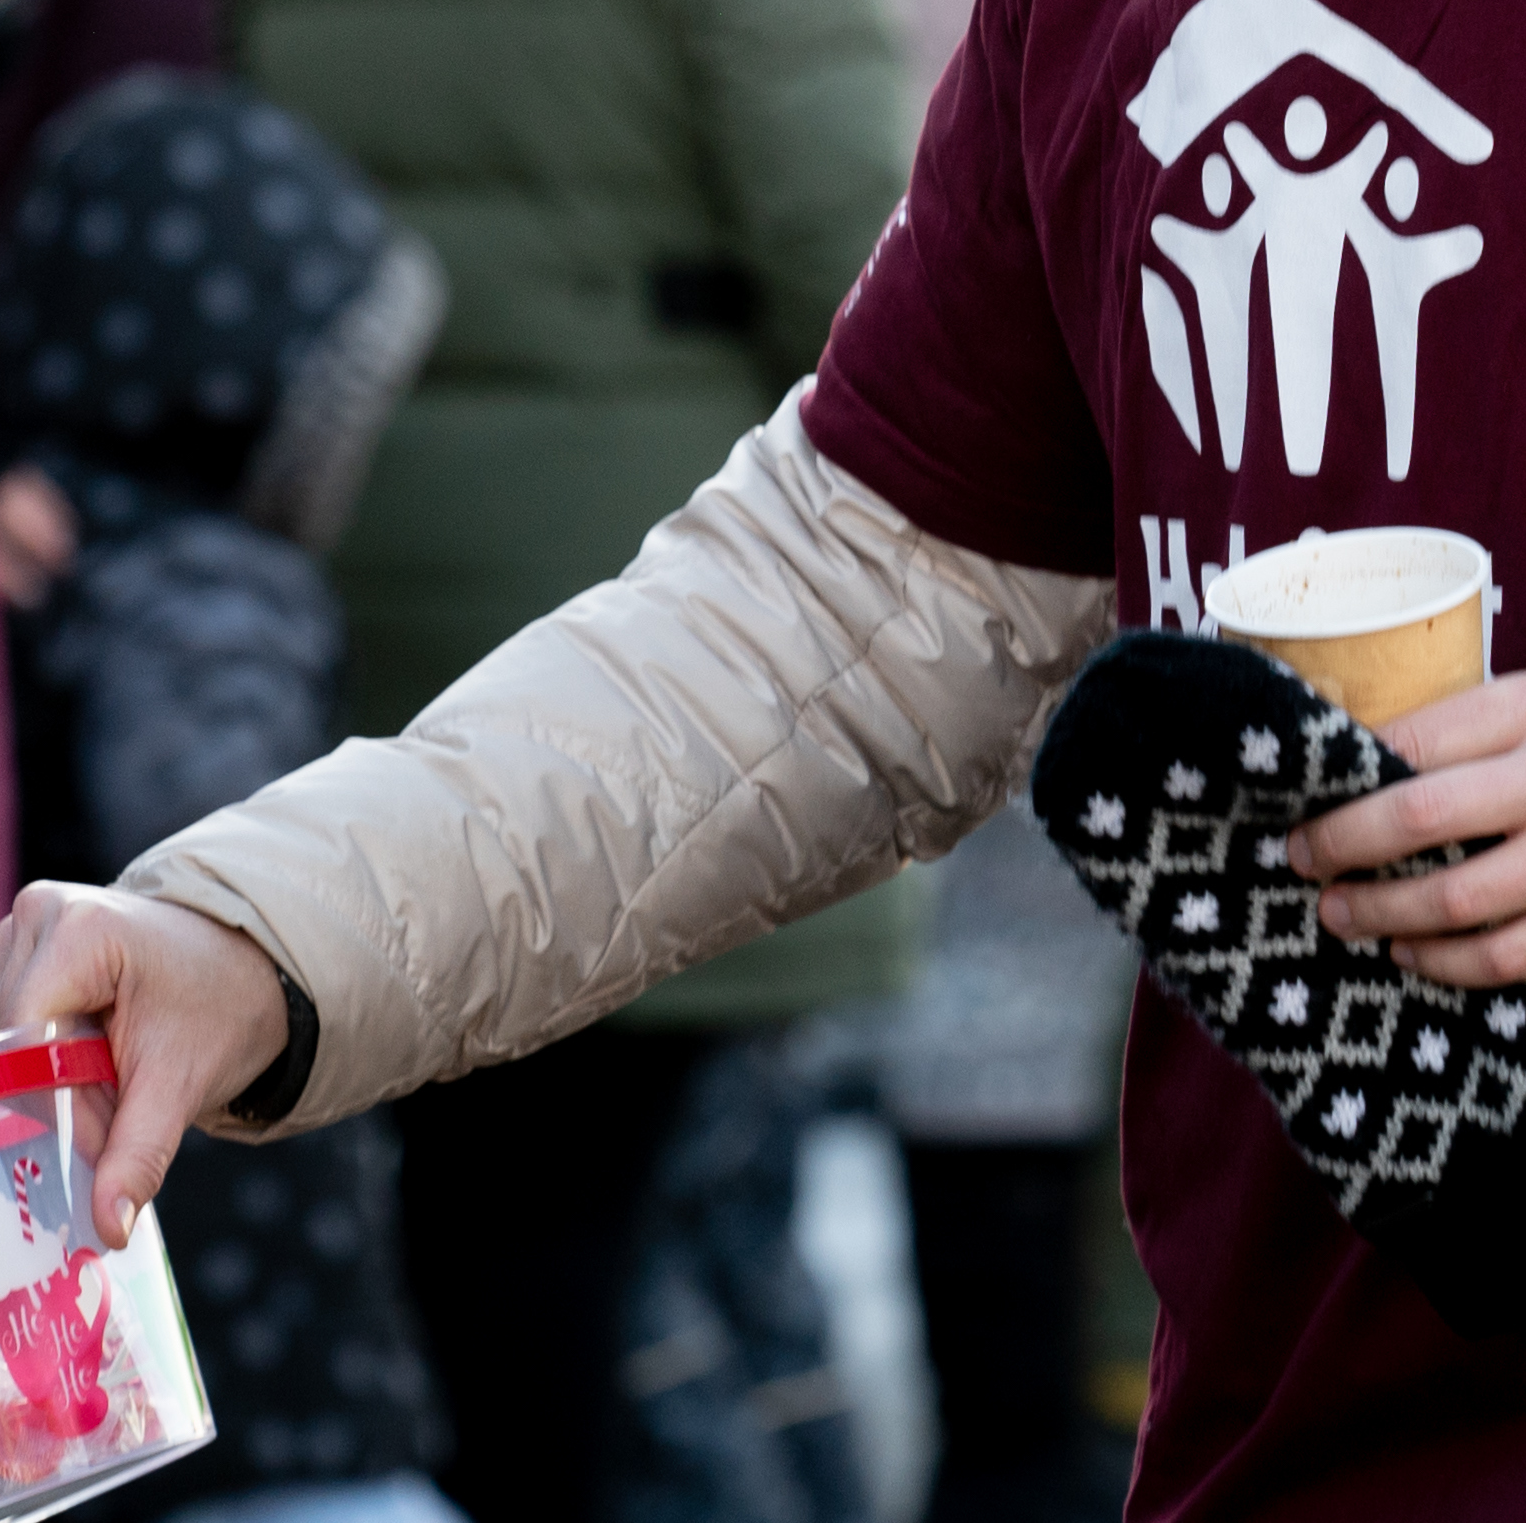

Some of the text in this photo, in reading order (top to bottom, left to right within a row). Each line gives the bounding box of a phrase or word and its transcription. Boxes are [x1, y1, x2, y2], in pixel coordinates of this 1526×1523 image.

[2, 1304, 45, 1358] Ho
[45, 1312, 85, 1364] Ho
[53, 1359, 93, 1414] Ho
